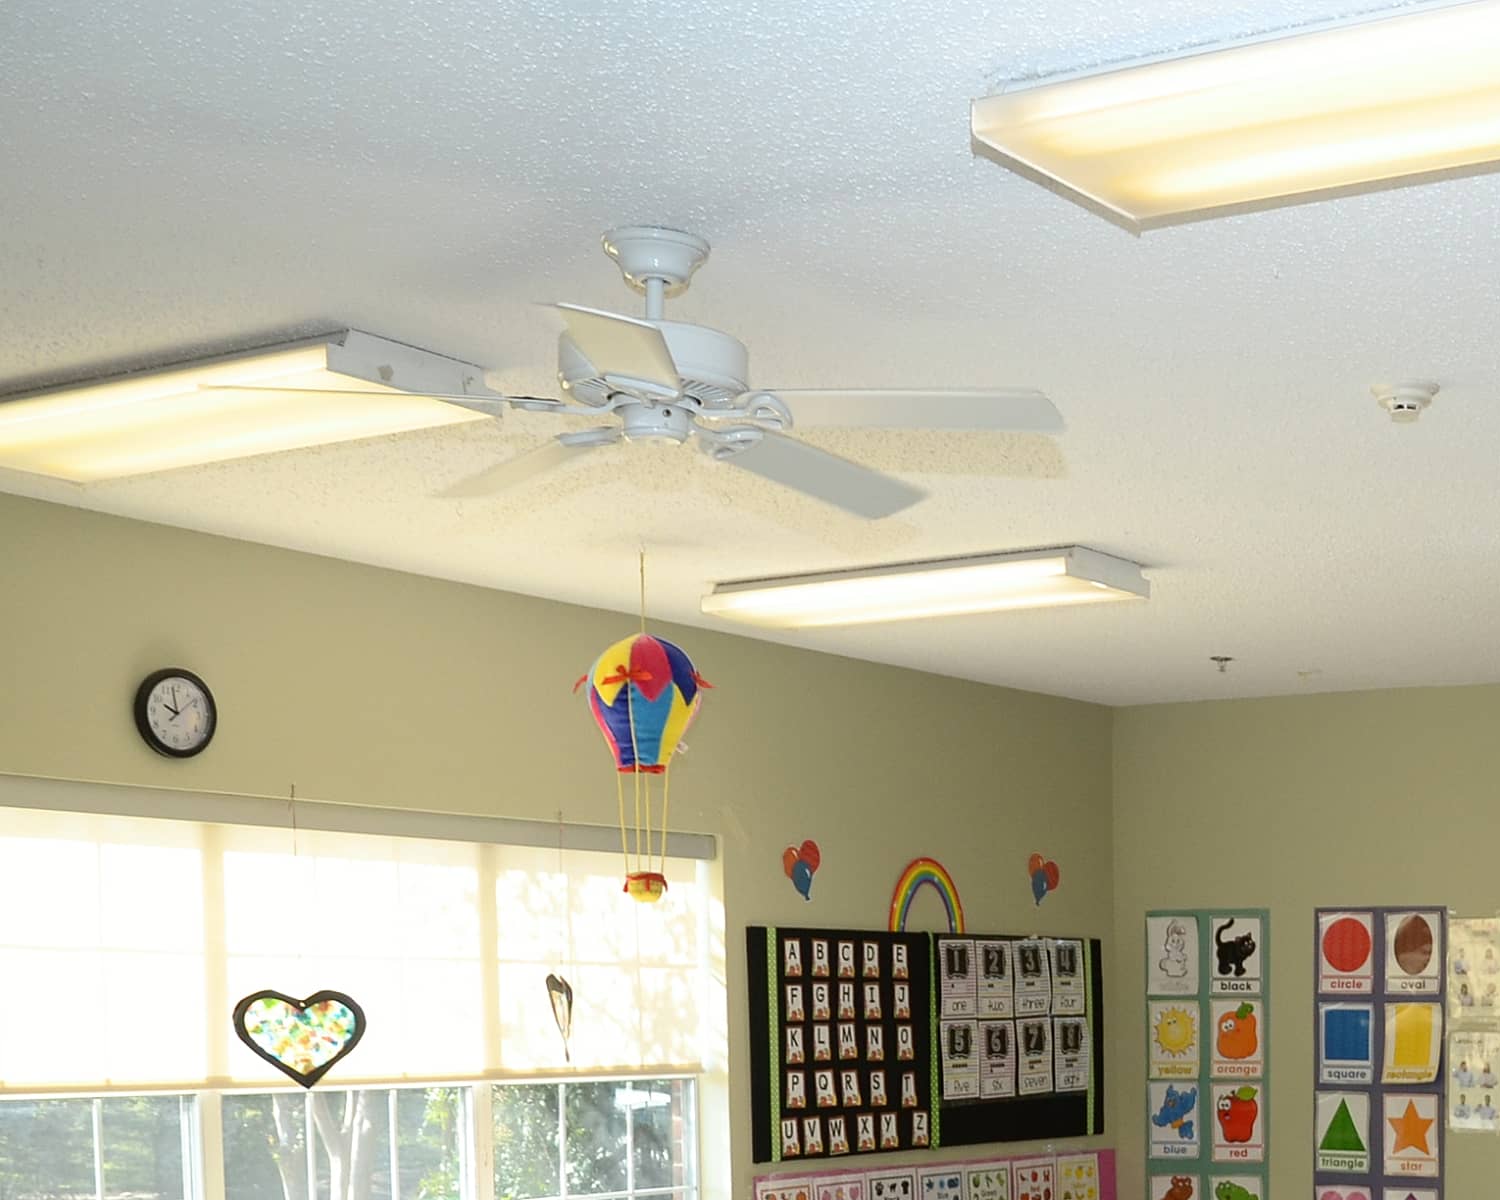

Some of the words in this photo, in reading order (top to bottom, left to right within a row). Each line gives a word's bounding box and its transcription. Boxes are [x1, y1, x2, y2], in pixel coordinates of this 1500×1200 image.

[788, 944, 797, 960] A
[817, 943, 824, 960] B
[841, 945, 850, 961] C
[867, 945, 875, 961] D
[897, 947, 904, 963] E
[954, 950, 960, 971] 1
[989, 951, 999, 973] 2
[1024, 951, 1035, 971] 3
[1060, 950, 1070, 971] 4
[1220, 982, 1252, 991] black
[1330, 979, 1363, 989] circle
[1400, 980, 1426, 990] oval
[791, 987, 798, 1004] F
[815, 986, 825, 1003] G
[843, 986, 850, 1000] H
[869, 987, 875, 1003] I
[899, 987, 905, 1002] J
[952, 1001, 967, 1011] one
[988, 1002, 1004, 1011] two
[1022, 999, 1045, 1010] three
[1060, 996, 1076, 1008] four
[790, 1030, 799, 1047] K
[817, 1028, 825, 1044] L
[842, 1027, 853, 1043] M
[871, 1031, 879, 1046] N
[901, 1028, 909, 1044] O
[954, 1030, 965, 1051] 5
[991, 1030, 1002, 1051] 6
[1029, 1029, 1039, 1049] 7
[1217, 1066, 1258, 1077] orange
[1327, 1069, 1367, 1080] square
[791, 1074, 800, 1091] P
[818, 1074, 828, 1091] Q
[845, 1074, 853, 1090] R
[873, 1074, 881, 1090] S
[904, 1076, 911, 1092] T
[953, 1077, 970, 1092] five
[991, 1078, 1003, 1090] six
[1023, 1075, 1048, 1089] seven
[784, 1121, 793, 1138] U
[808, 1120, 816, 1137] V
[830, 1120, 842, 1137] W
[861, 1118, 869, 1134] X
[884, 1116, 892, 1132] Y
[916, 1115, 923, 1131] Z
[1163, 1145, 1187, 1154] blue
[1229, 1148, 1248, 1158] red
[1321, 1158, 1364, 1169] triangle
[1400, 1162, 1423, 1171] star
